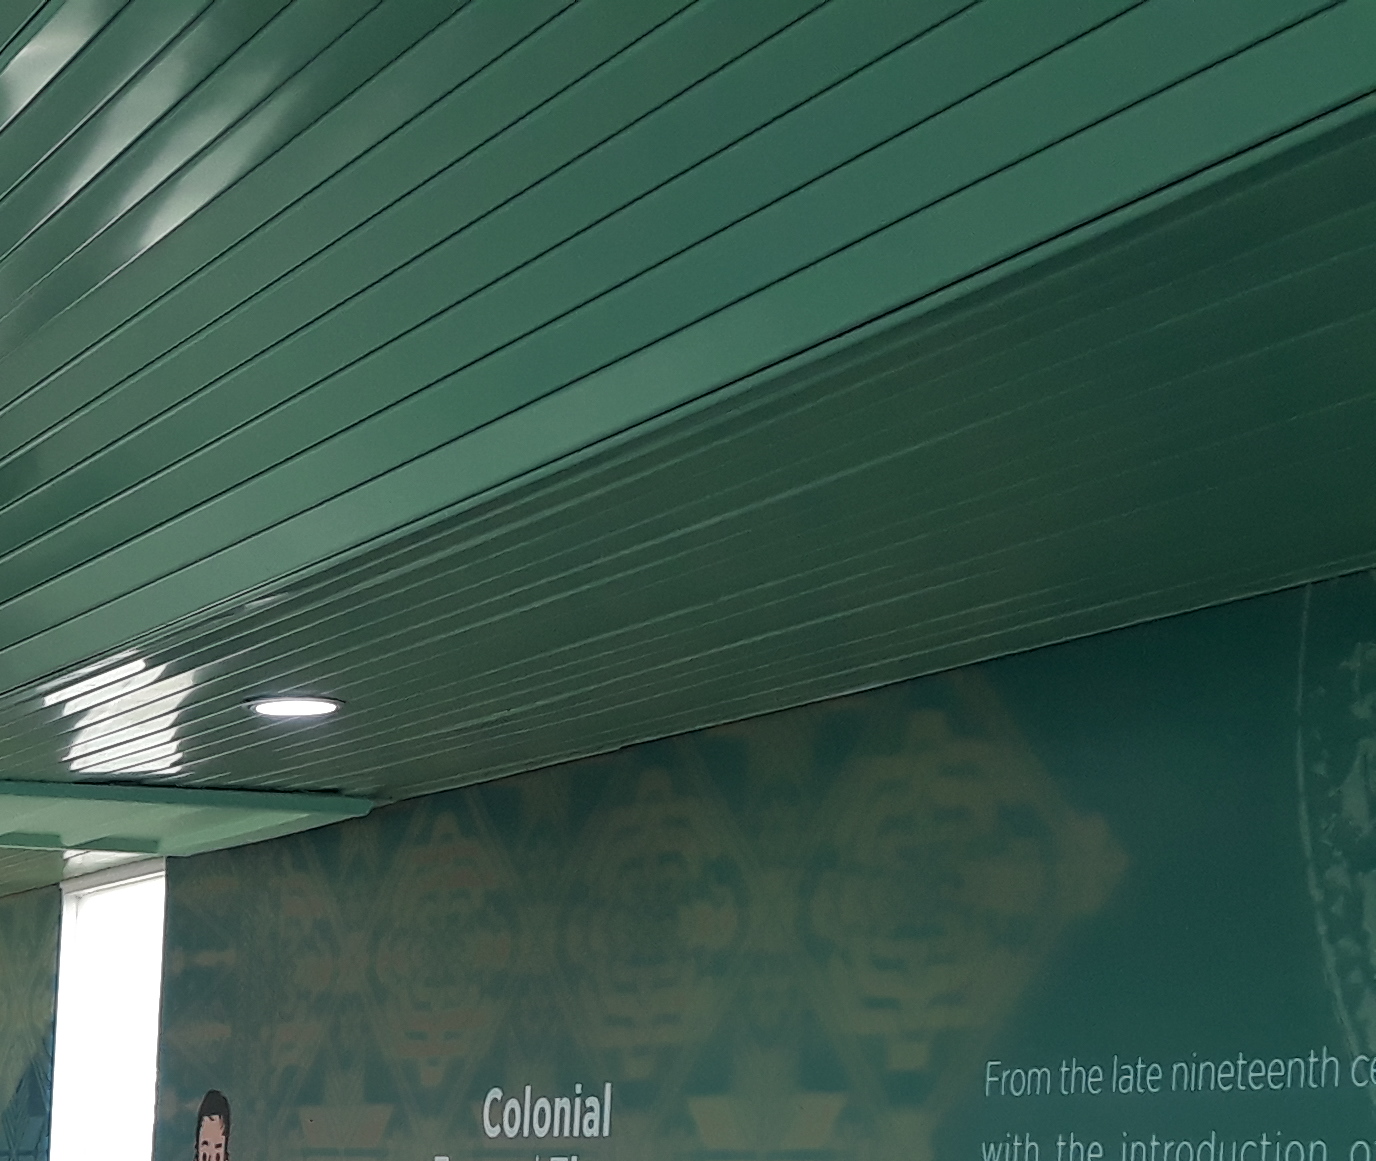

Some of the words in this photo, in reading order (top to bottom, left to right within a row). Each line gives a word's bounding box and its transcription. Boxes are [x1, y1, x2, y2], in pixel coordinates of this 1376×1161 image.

[985, 1060, 1051, 1097] From
[1060, 1057, 1104, 1095] the
[1112, 1054, 1163, 1094] late
[1171, 1045, 1339, 1092] nineteenth
[482, 1082, 612, 1138] Colonial
